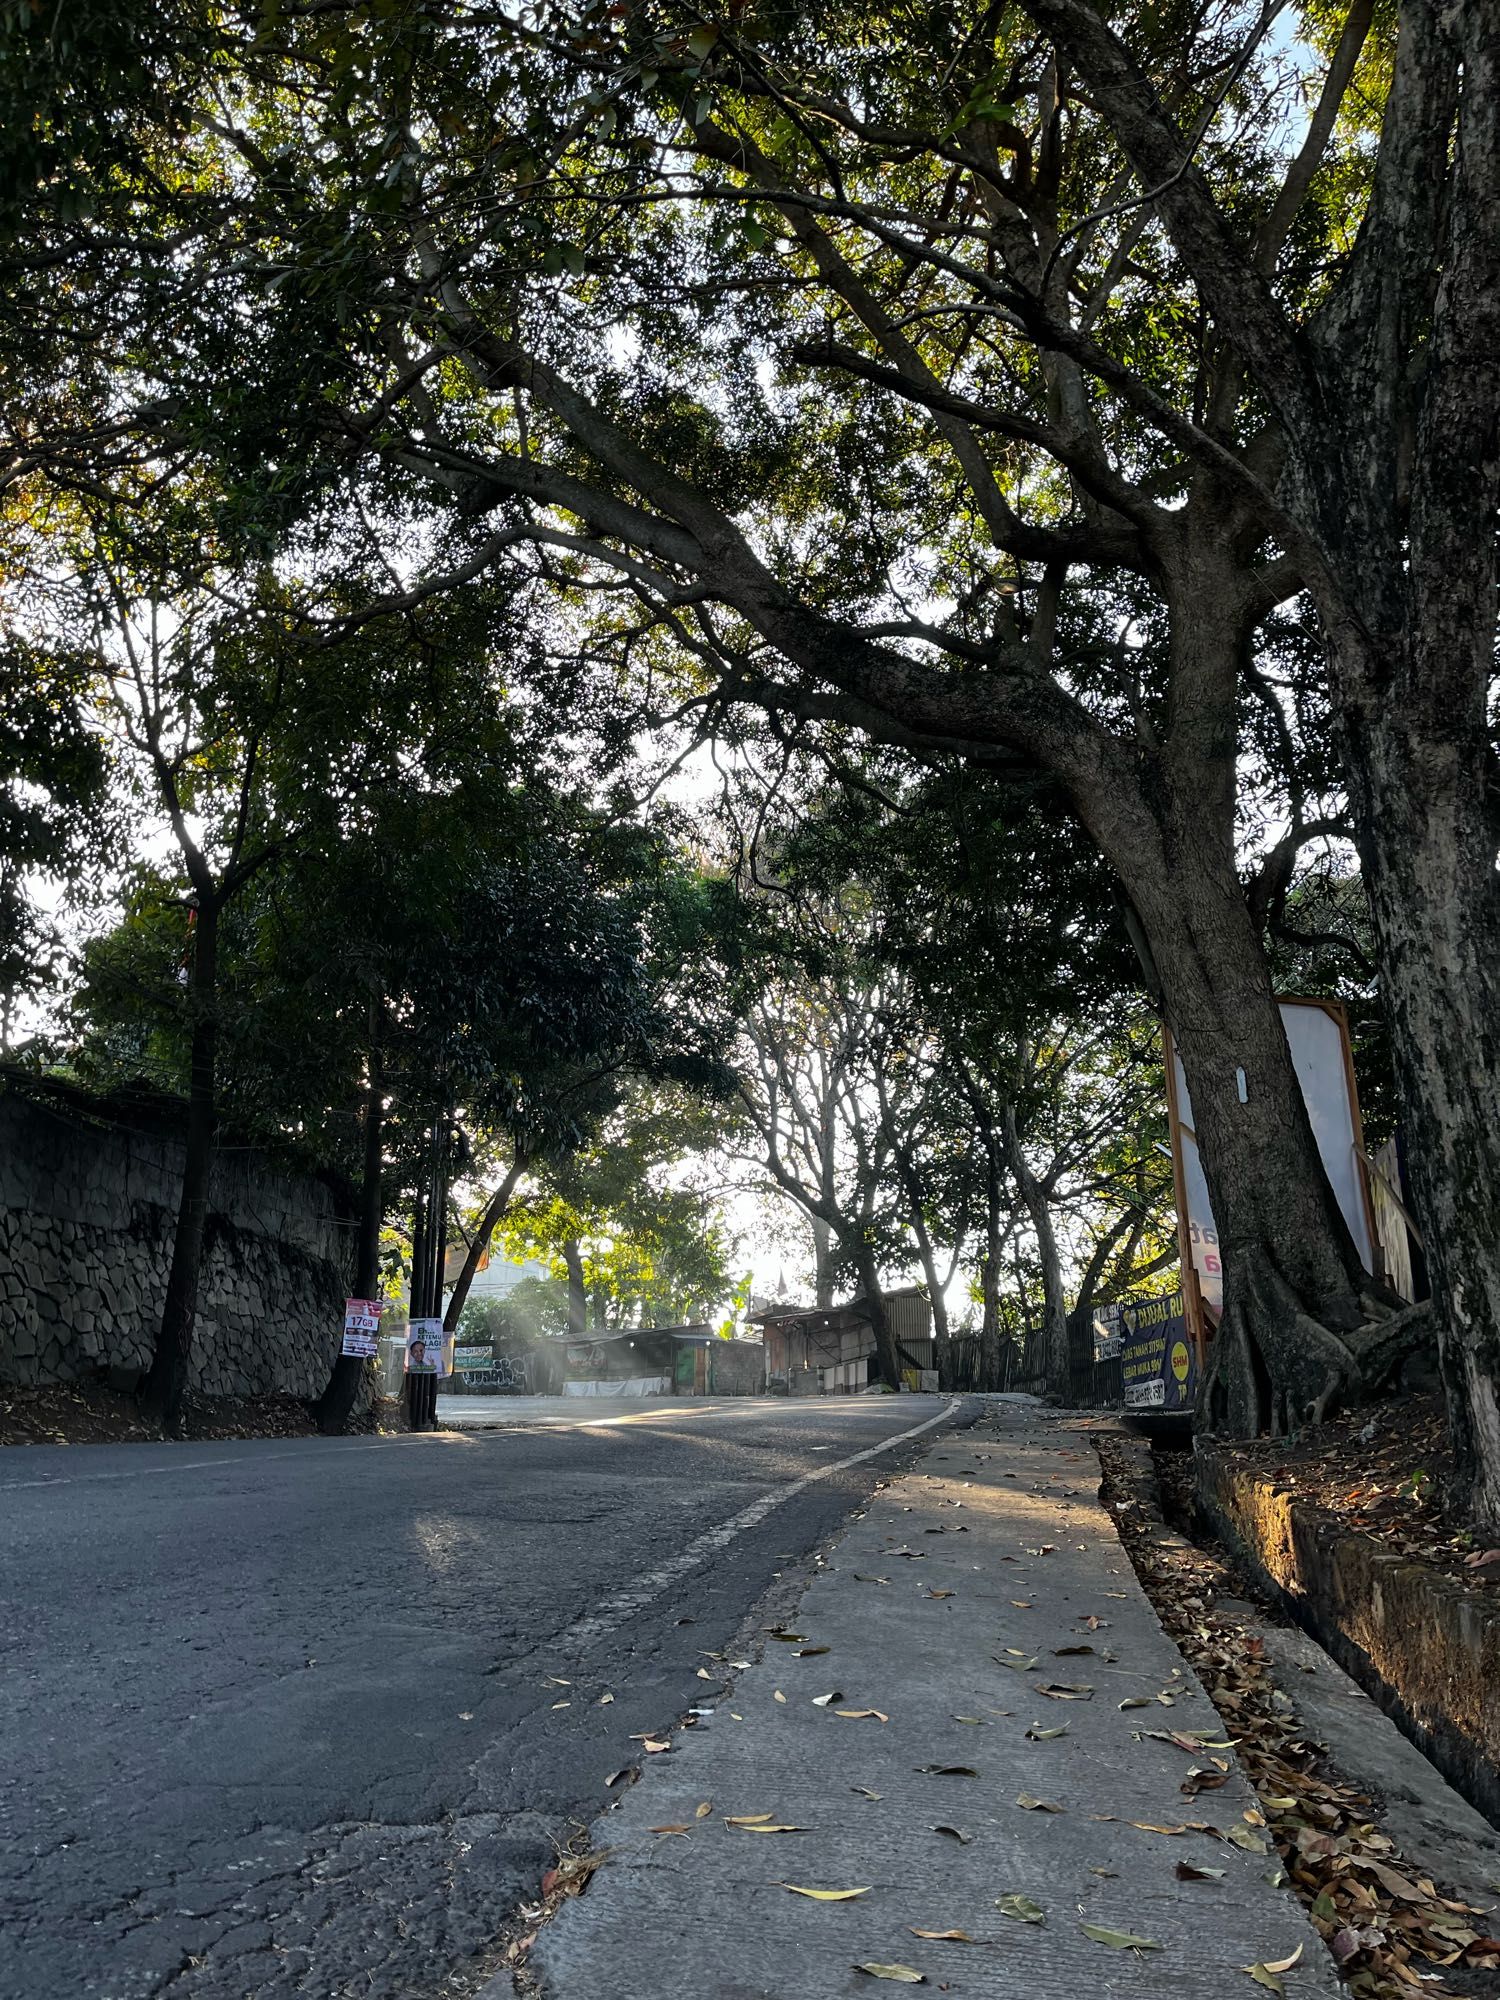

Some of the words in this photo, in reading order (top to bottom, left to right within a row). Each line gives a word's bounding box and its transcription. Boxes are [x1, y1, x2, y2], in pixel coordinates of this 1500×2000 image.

[1138, 1301, 1169, 1328] DIJUAL
[351, 1316, 373, 1327] 17GB
[1172, 1355, 1188, 1368] SHM
